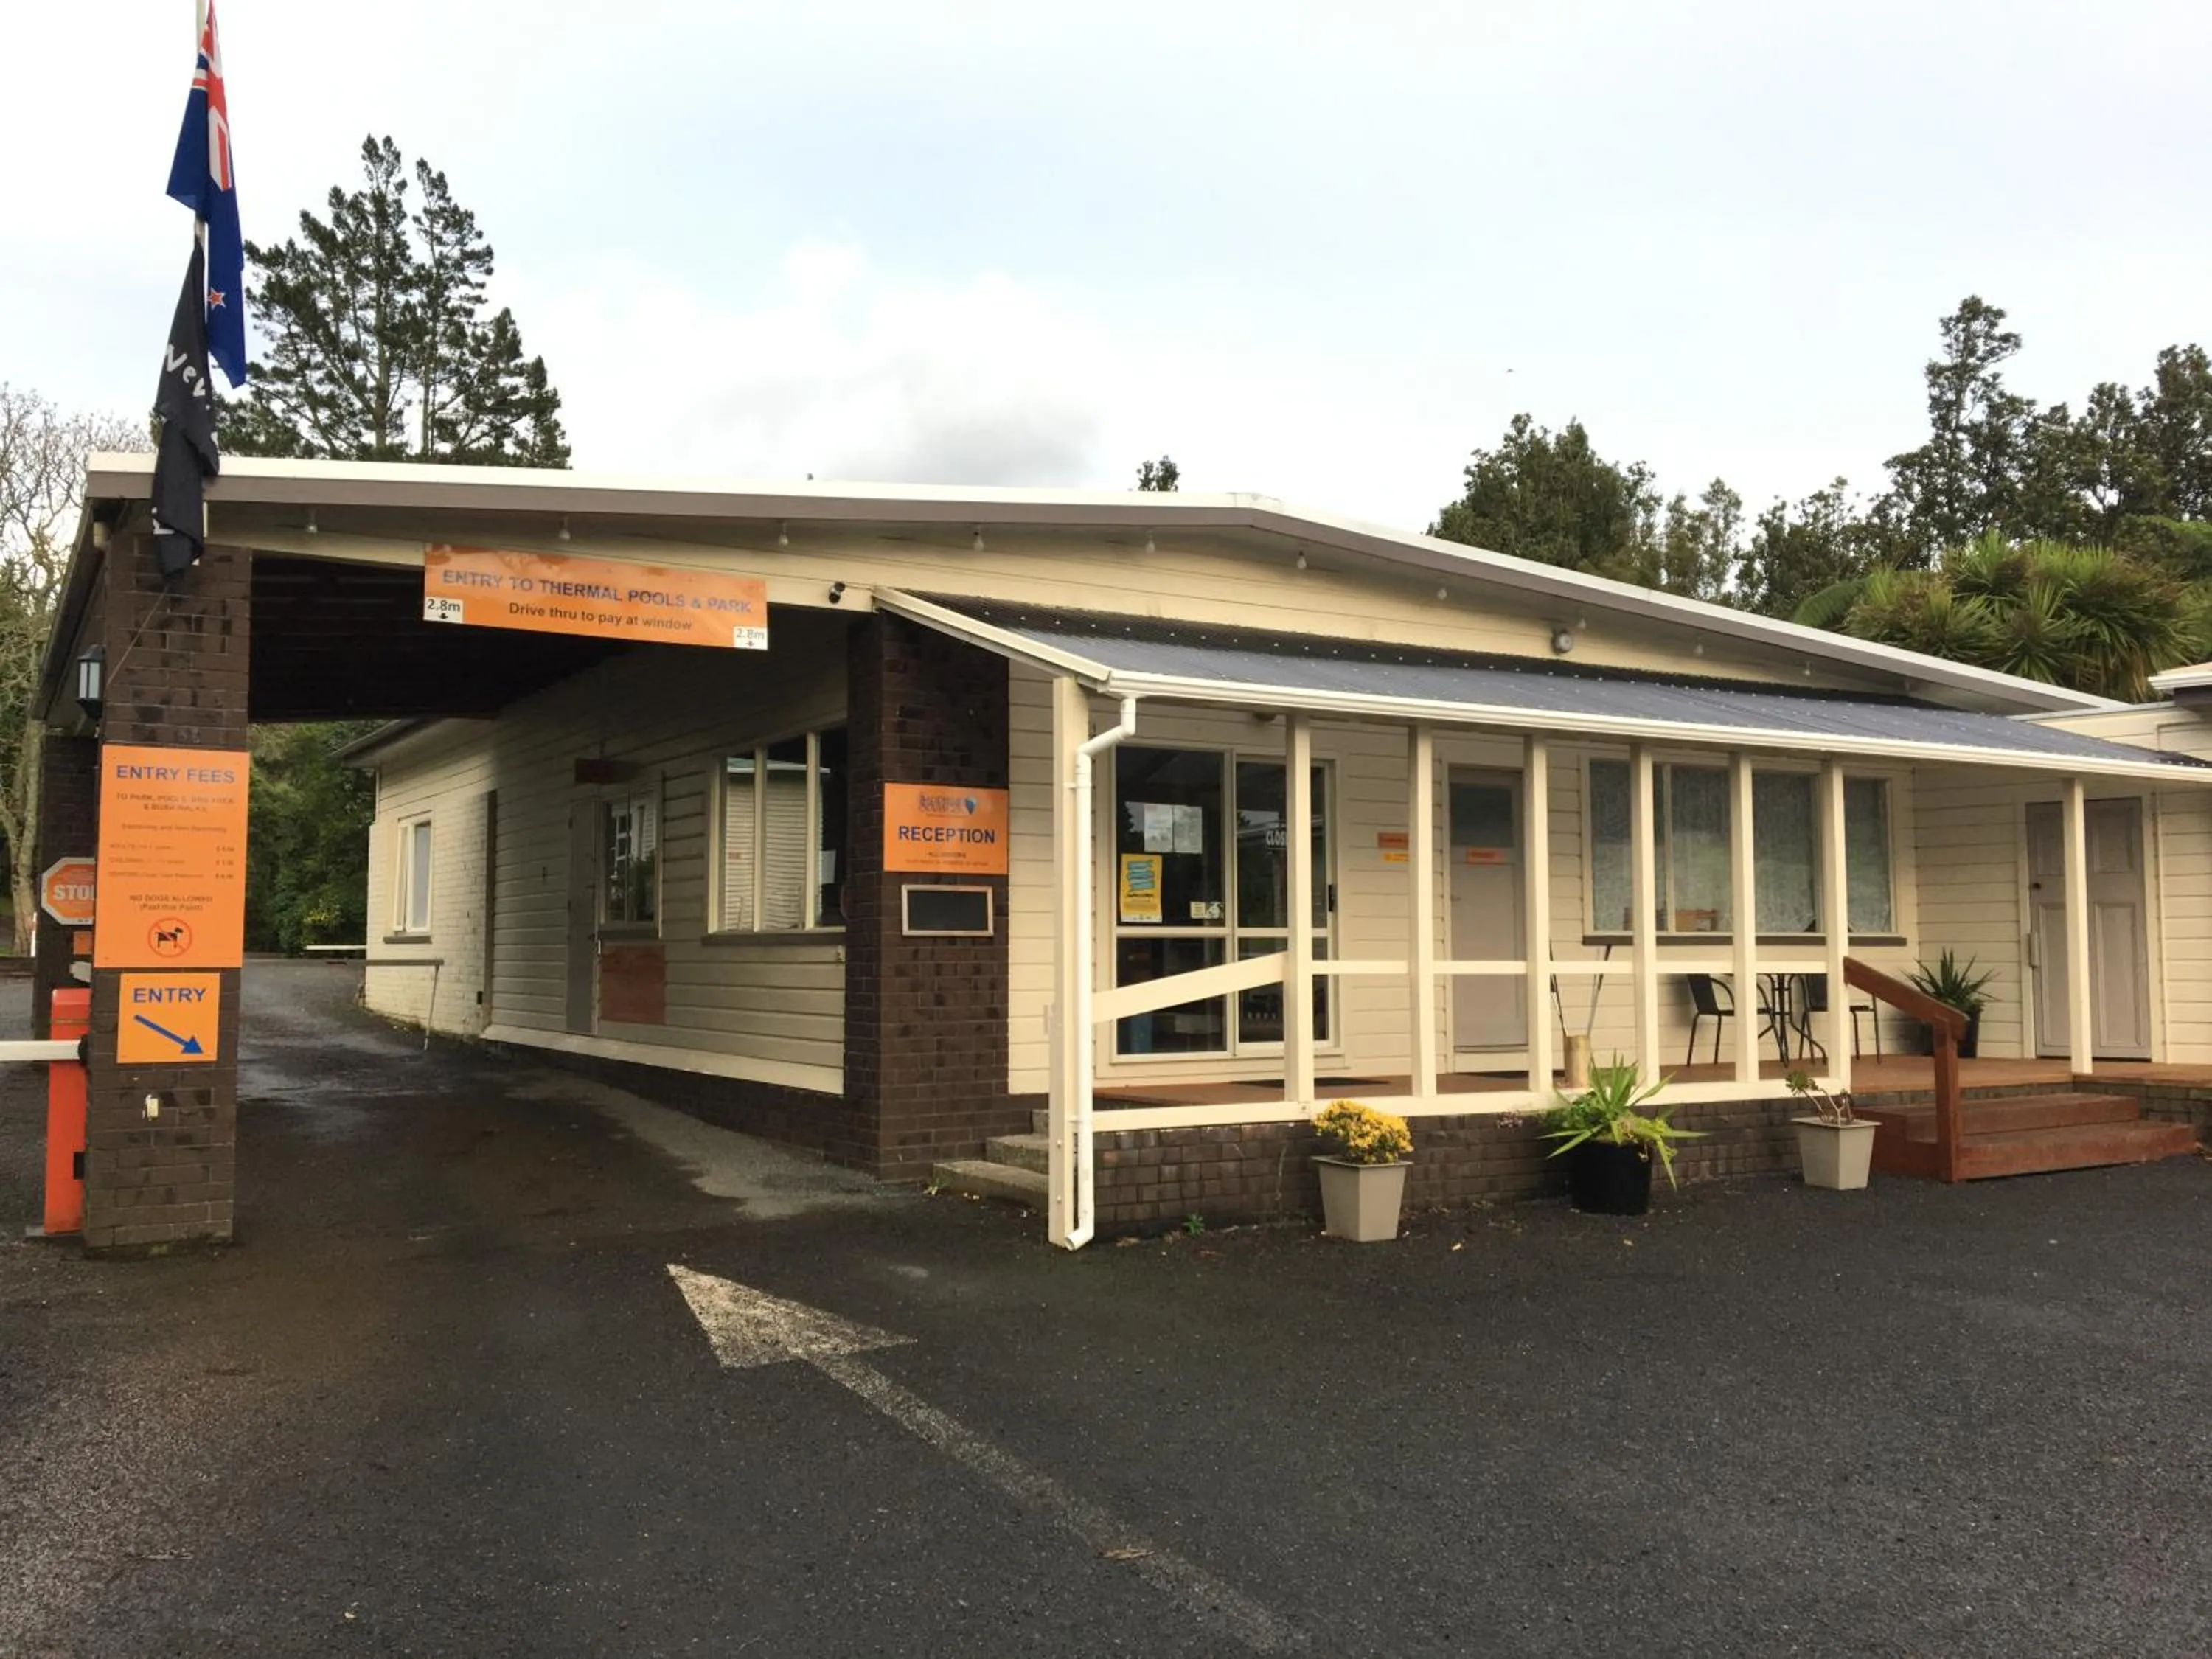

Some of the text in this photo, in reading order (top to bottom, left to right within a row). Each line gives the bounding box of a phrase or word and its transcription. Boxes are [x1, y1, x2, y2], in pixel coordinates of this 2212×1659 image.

[443, 569, 752, 613] ENTRY TO THERMAL POOLS & PARK
[427, 599, 461, 613] 2.8m
[509, 602, 692, 631] Drive thru to pay at window
[736, 628, 765, 641] 2.8m
[116, 765, 236, 784] ENTRY FEES
[898, 825, 995, 844] RECEPTION
[133, 987, 206, 1004] ENTRY
